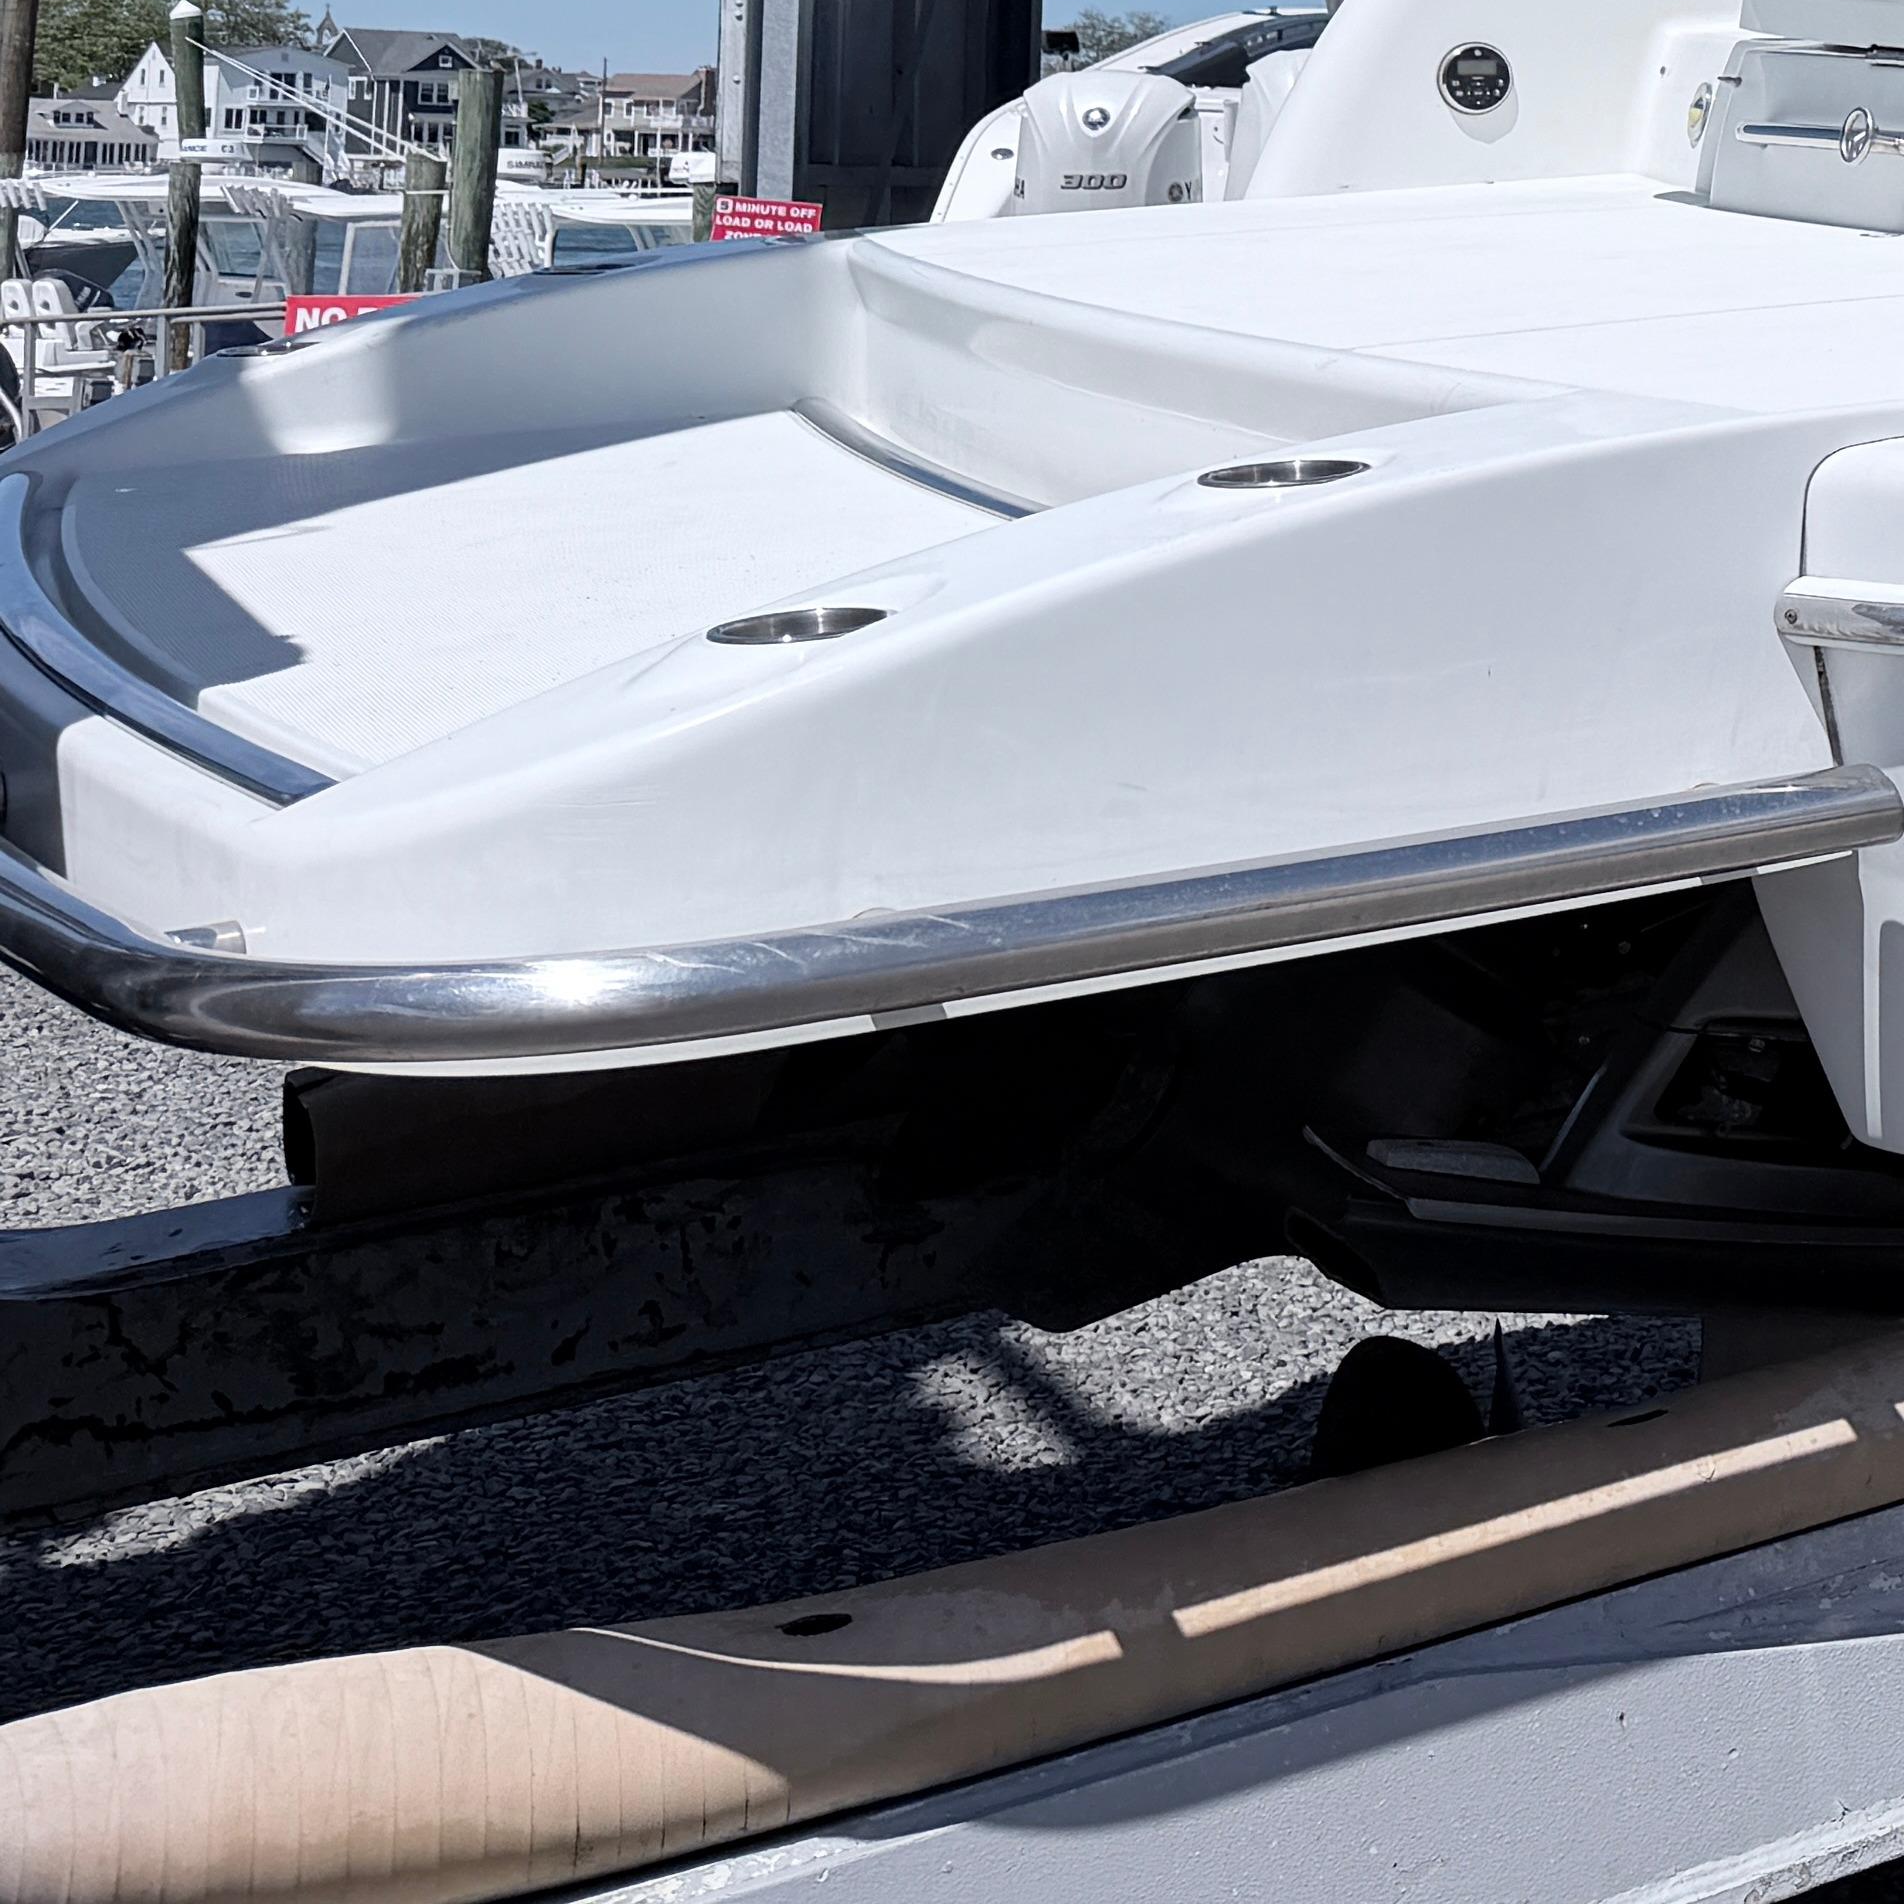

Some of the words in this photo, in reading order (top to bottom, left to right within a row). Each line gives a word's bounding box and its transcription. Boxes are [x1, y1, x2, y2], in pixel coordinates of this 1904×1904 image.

[1060, 173, 1128, 190] 300
[734, 201, 788, 216] MINUTE
[789, 206, 817, 219] OFF
[715, 214, 752, 228] LOAD
[753, 217, 775, 230] OR
[776, 220, 813, 234] LOAD
